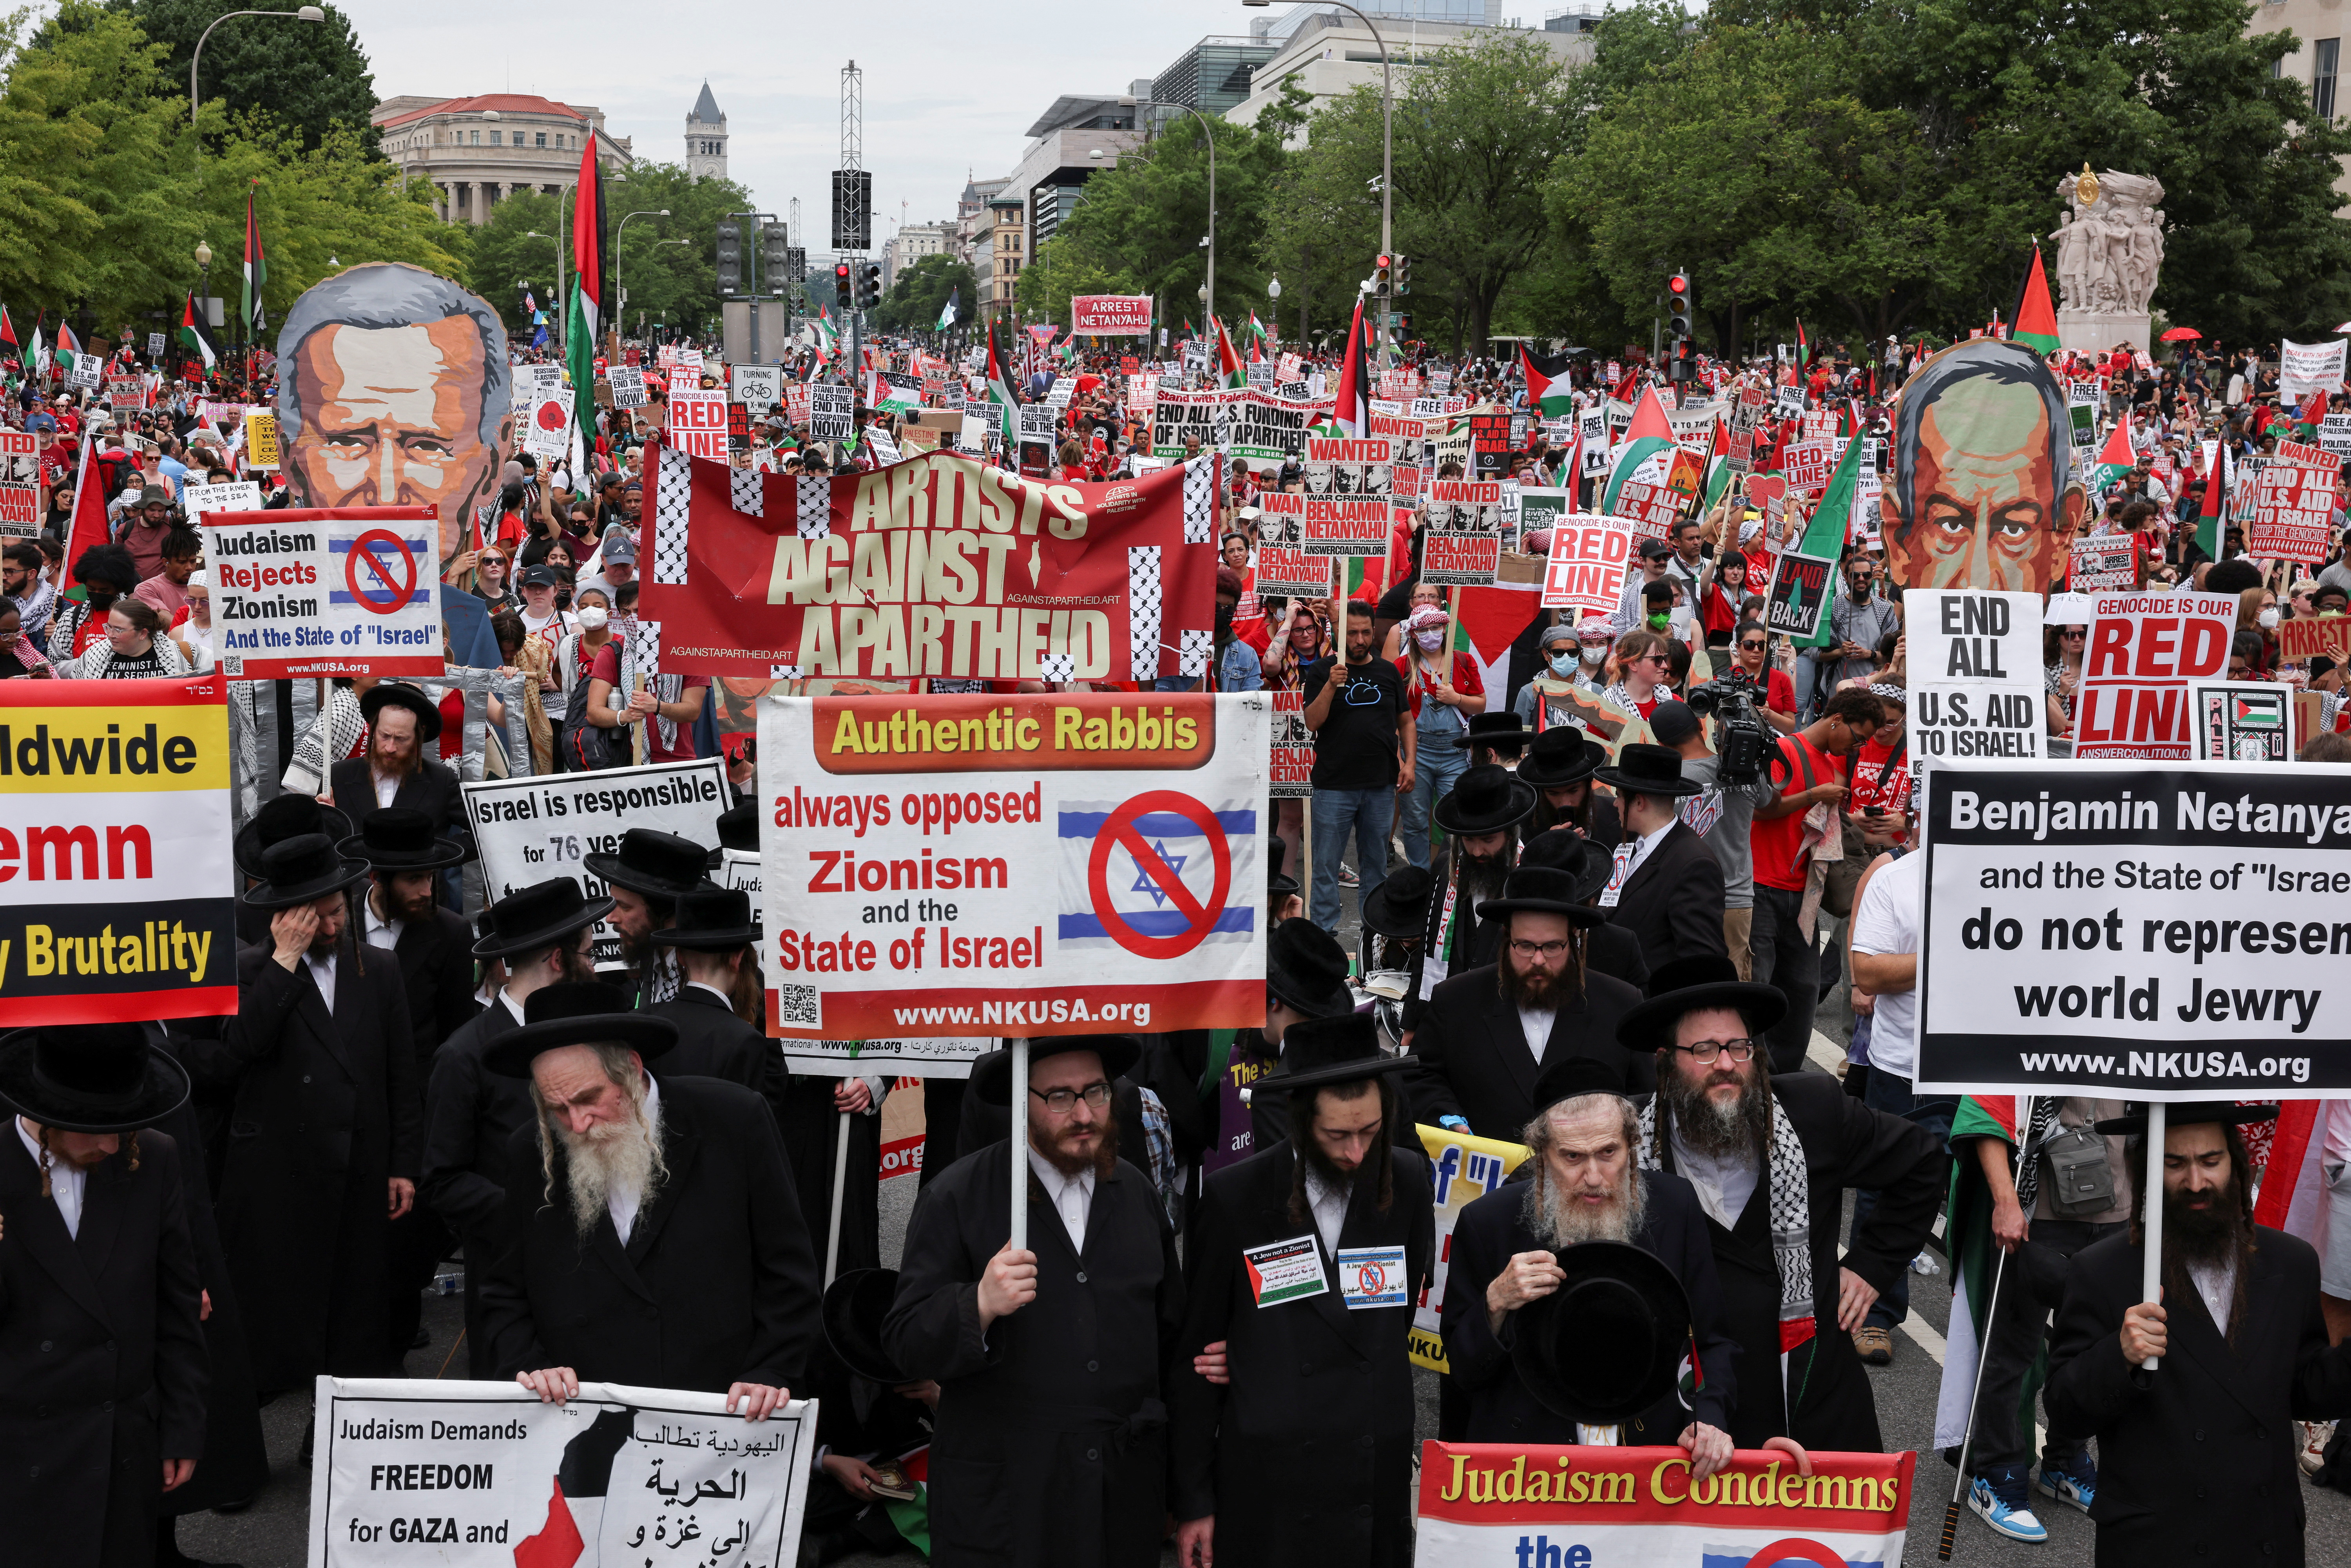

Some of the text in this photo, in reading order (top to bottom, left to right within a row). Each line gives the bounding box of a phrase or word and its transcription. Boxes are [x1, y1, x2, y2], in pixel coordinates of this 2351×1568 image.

[1092, 302, 1139, 312] ARREST
[1081, 315, 1147, 326] NETANYAHU
[1188, 342, 1206, 352] FREE
[813, 393, 851, 403] PALESTINE!
[813, 401, 852, 413] END THE
[1157, 391, 1189, 403] Stand
[1192, 393, 1215, 403] with
[1219, 392, 1278, 406] Palestinian
[812, 413, 851, 422] OCCUPATION
[1156, 404, 1211, 423] END ALL
[1245, 404, 1304, 429] FUNDING
[812, 420, 849, 437] NOW!
[1155, 425, 1173, 444] OF
[1309, 439, 1389, 461] WANTED
[2262, 468, 2335, 492] END ALL
[189, 489, 210, 498] FROM
[850, 454, 1089, 540] ARTISTS
[1096, 500, 1131, 508] SOLIDARITY
[1105, 493, 1130, 502] ARTISTS
[2260, 488, 2332, 511] U.S. AID
[1107, 505, 1136, 514] PALESTINE
[1306, 502, 1387, 521] BENJAMIN
[2257, 508, 2329, 528] TO ISRAEL
[216, 529, 315, 556] Judaism
[1306, 521, 1387, 539] NETANYAHU
[2255, 526, 2327, 541] STOP THE GENOCIDE
[1304, 546, 1386, 555] ANSWERCOALITION.ORG
[2104, 555, 2129, 564] ARREST
[220, 561, 316, 592] Rejects
[767, 530, 1017, 607] AGAINST
[1781, 561, 1824, 589] LAND
[2104, 561, 2130, 570] NETANYAHU!
[223, 594, 317, 619] Zionism
[1007, 594, 1120, 605] AGAINSTAPARTHEID.ART
[2098, 598, 2173, 614] GENOCIDE
[2178, 599, 2193, 613] IS
[2198, 600, 2232, 616] OUR
[1771, 601, 1813, 629] BACK
[1941, 596, 2010, 636] END
[225, 624, 436, 649] And the State of "Israel"
[797, 605, 1110, 679] APARTHEID
[2088, 618, 2228, 677] RED
[2283, 617, 2351, 656] ARREST
[670, 646, 792, 660] AGAINSTAPARTHEID.ART
[1947, 638, 2007, 678] ALL
[286, 662, 369, 674] www.NKUSA.org
[1918, 693, 2033, 729] U.S. AID
[831, 707, 1198, 754] Authentic Rabbis
[1916, 730, 2035, 757] TO ISRAEL!
[473, 774, 718, 824] Israel is responsible
[775, 780, 1041, 837] always opposed
[1950, 791, 2158, 840] Benjamin
[523, 835, 580, 863] for 76
[808, 848, 1008, 893] Zionism
[1980, 861, 2043, 888] and
[2054, 861, 2104, 888] the
[2115, 861, 2202, 890] State
[2210, 864, 2244, 890] of
[862, 898, 958, 923] and the
[1961, 907, 2023, 950] do
[2042, 907, 2123, 951] not
[26, 920, 211, 982] Brutality
[780, 926, 1042, 972] State of Israel
[893, 999, 1151, 1026] www.NKUSA.org
[2014, 976, 2321, 1033] world Jewry
[2020, 1052, 2310, 1082] www.NKUSA.org
[340, 1418, 527, 1441] Judaism Demands
[370, 1464, 493, 1491] FREEDOM
[645, 1458, 746, 1507] الحرية
[1441, 1454, 1898, 1512] Judaism Condemns
[349, 1517, 509, 1545] for GAZA and
[627, 1525, 645, 1548] و
[655, 1515, 701, 1549] غزة
